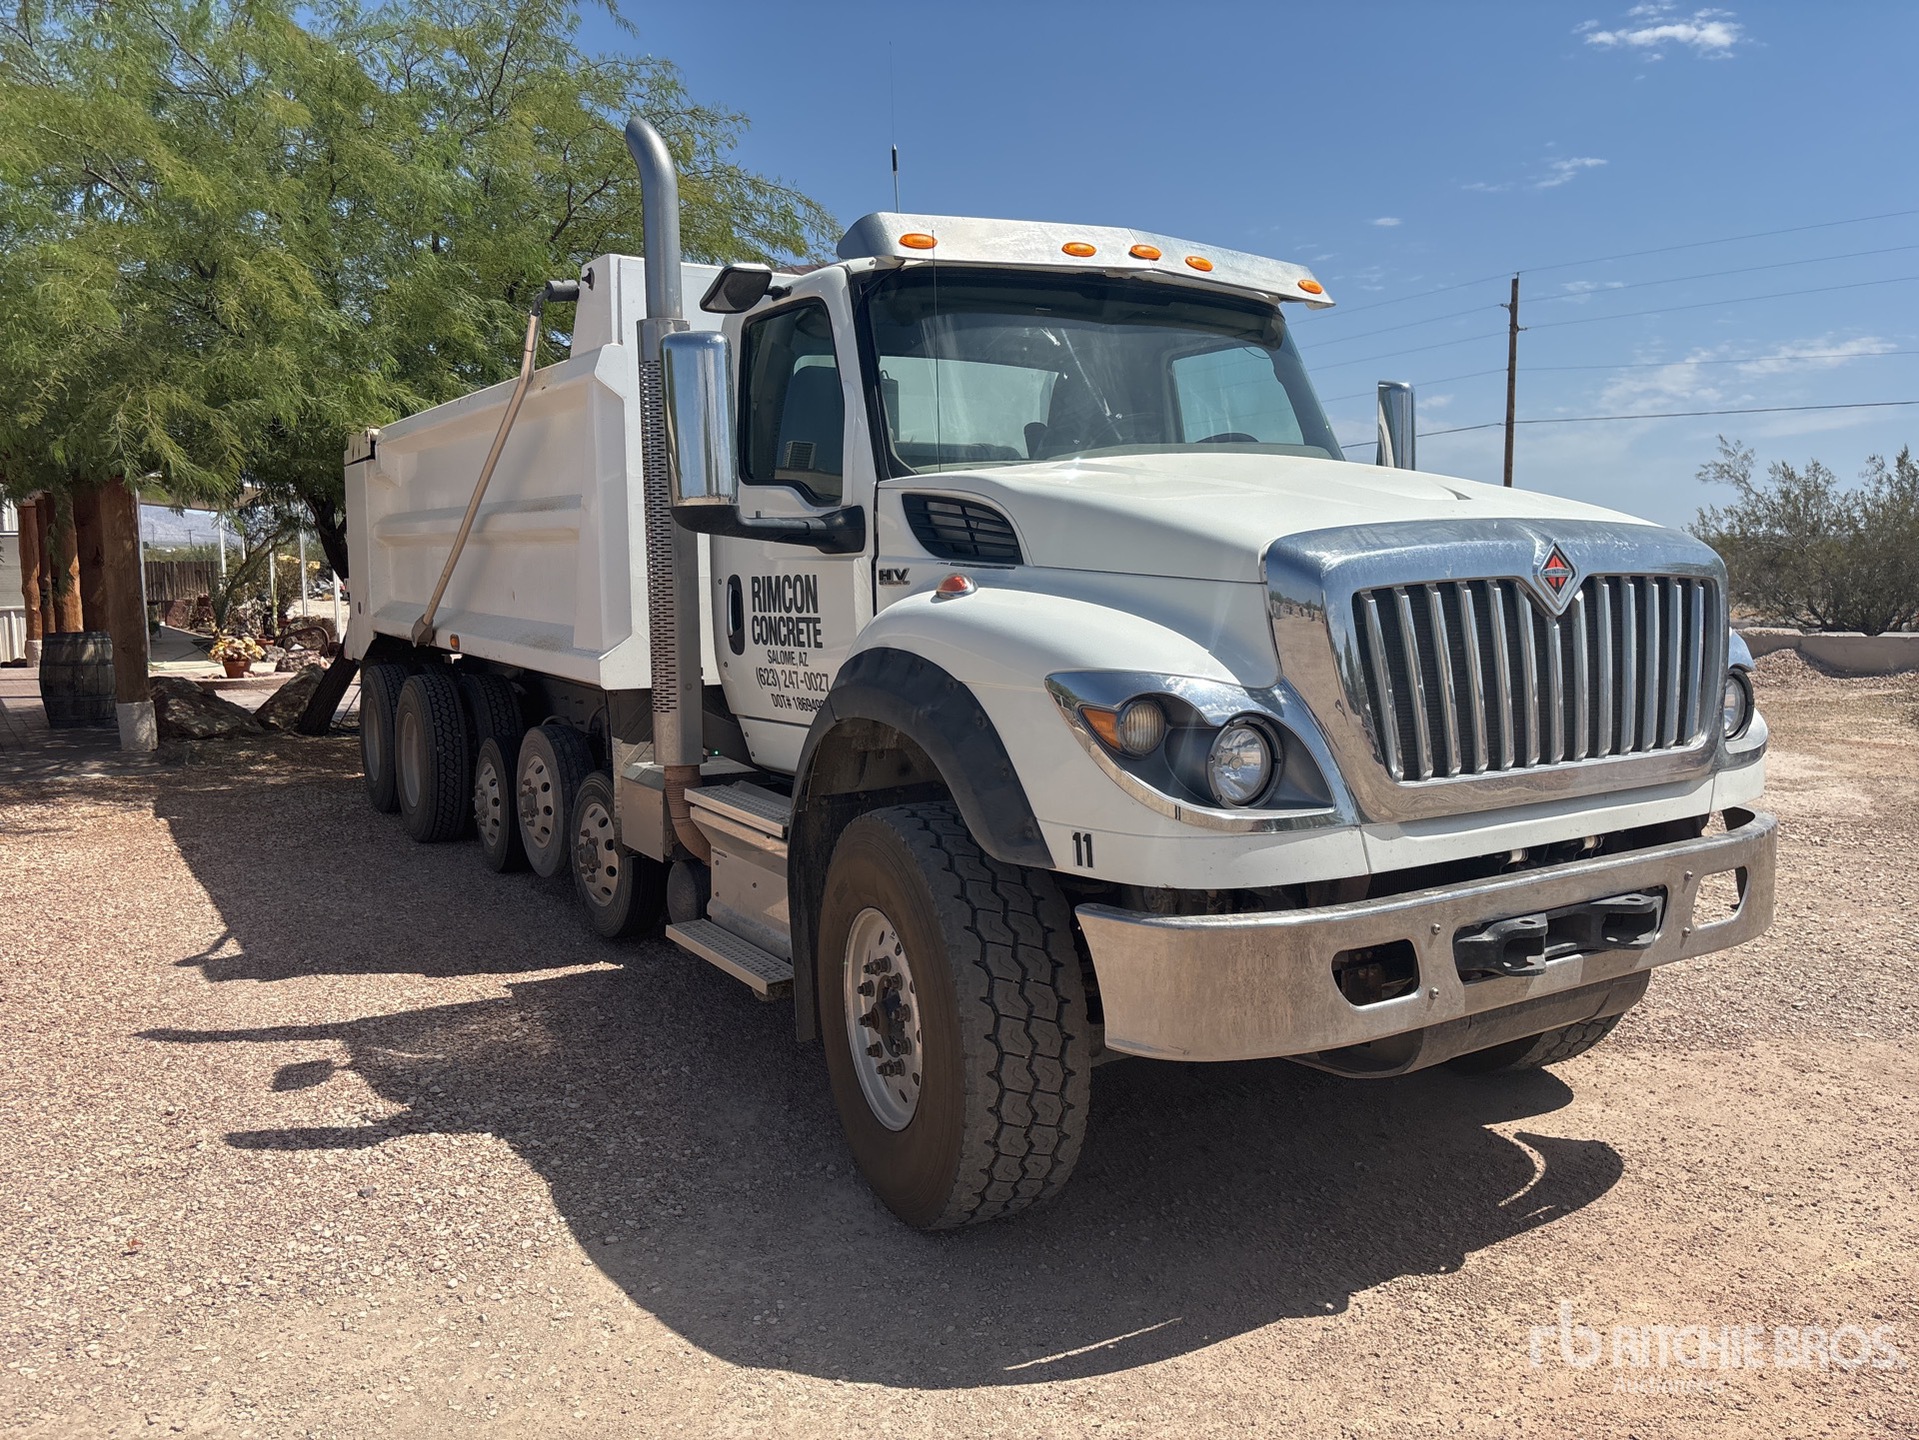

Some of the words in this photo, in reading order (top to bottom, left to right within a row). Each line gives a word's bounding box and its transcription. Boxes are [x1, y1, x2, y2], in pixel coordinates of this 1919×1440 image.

[878, 568, 910, 581] HV
[751, 574, 818, 614] RIMCON
[751, 615, 823, 648] CONCRETE
[767, 649, 798, 668] SALOME,
[799, 651, 809, 667] AZ
[755, 666, 781, 691] (623)
[781, 669, 830, 692] 247-0027
[771, 693, 792, 709] DOT#
[1072, 831, 1093, 868] 11
